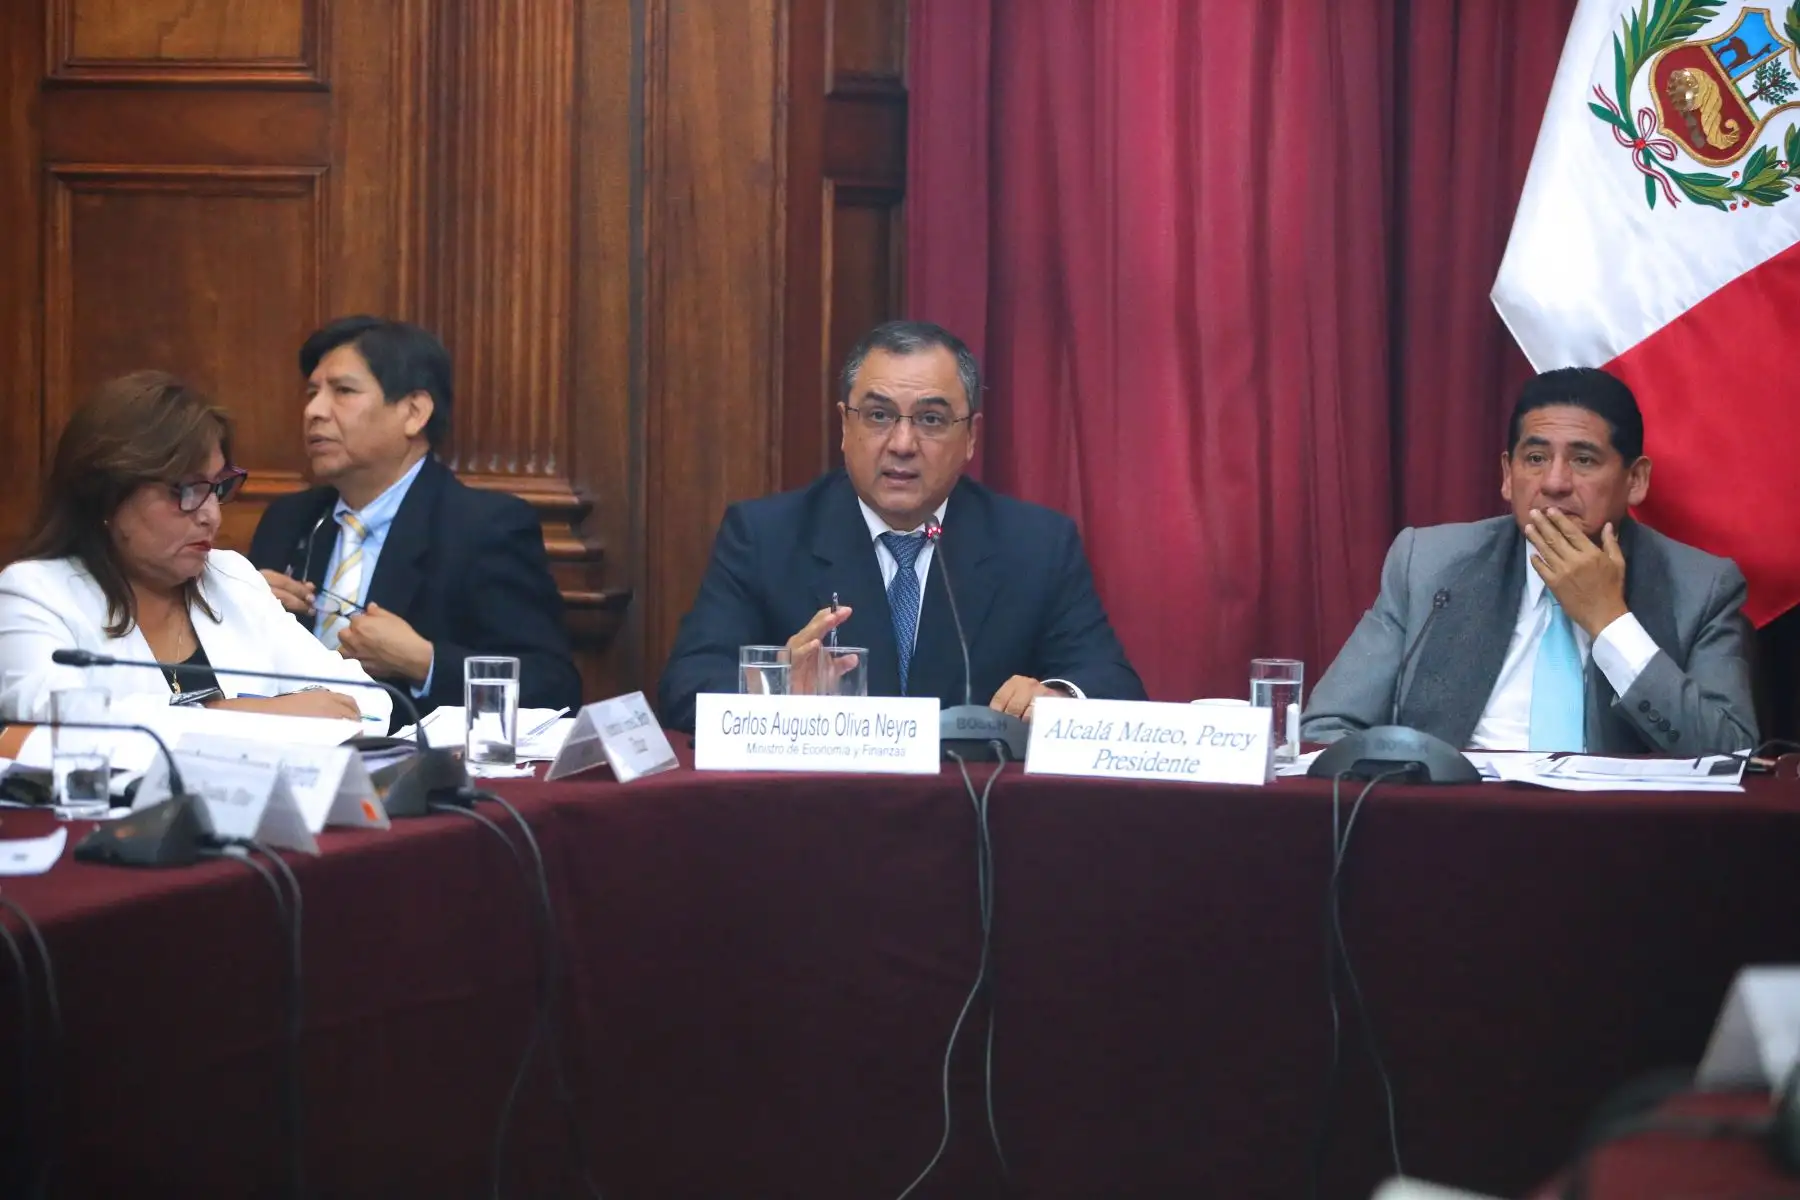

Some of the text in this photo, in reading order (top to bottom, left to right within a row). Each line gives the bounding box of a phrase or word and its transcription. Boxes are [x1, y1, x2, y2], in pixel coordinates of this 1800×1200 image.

[721, 709, 918, 744] Carlos Augusto Oliva Neyra
[1045, 718, 1258, 750] Alcalá Mateo, Percy
[746, 742, 785, 755] Ministro
[786, 743, 800, 755] de
[853, 746, 860, 759] y
[862, 744, 906, 758] Finanzas
[1091, 749, 1201, 774] Presidente
